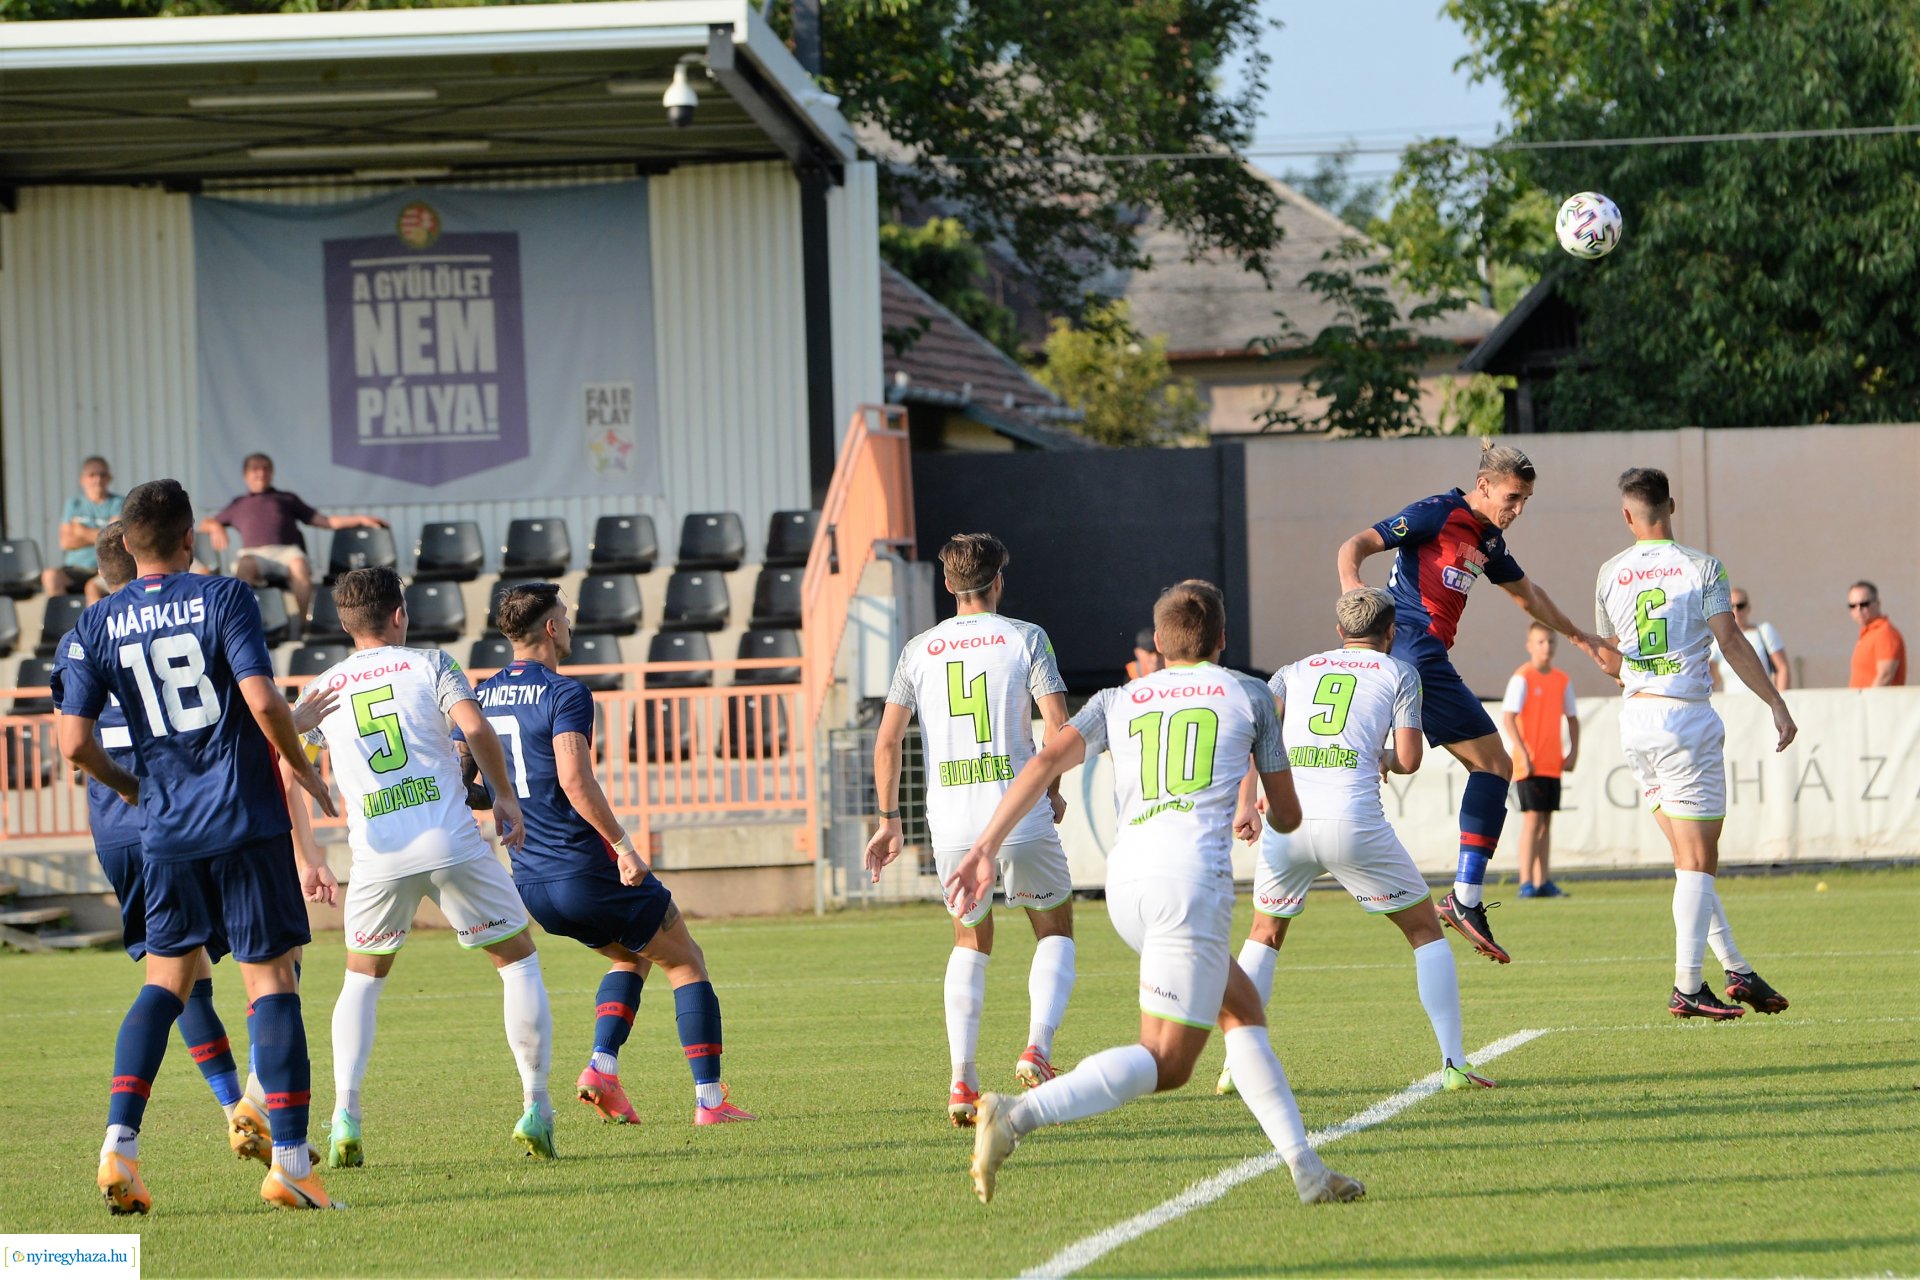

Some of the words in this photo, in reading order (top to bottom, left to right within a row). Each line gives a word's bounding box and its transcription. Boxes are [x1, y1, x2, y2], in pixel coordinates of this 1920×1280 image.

[353, 272, 371, 301] A
[352, 299, 498, 378] NEM
[356, 377, 500, 437] PÁLYA!
[585, 388, 632, 407] FAIR
[585, 408, 632, 427] PLAY
[1635, 567, 1683, 581] VEOLIA
[106, 597, 206, 641] MÁRKUS
[1635, 587, 1668, 657] 6
[949, 634, 1006, 650] VEOLIA
[351, 661, 412, 683] VEOLIA
[1330, 660, 1381, 671] VEOLIA
[118, 632, 222, 738] 18
[946, 660, 993, 744] 4
[1158, 685, 1226, 699] VEOLIA
[1308, 673, 1358, 737] 9
[350, 683, 409, 774] 5
[939, 752, 1015, 787] BUDAÖRS
[1128, 707, 1219, 801] 10
[1288, 744, 1359, 769] BUDAÖRS
